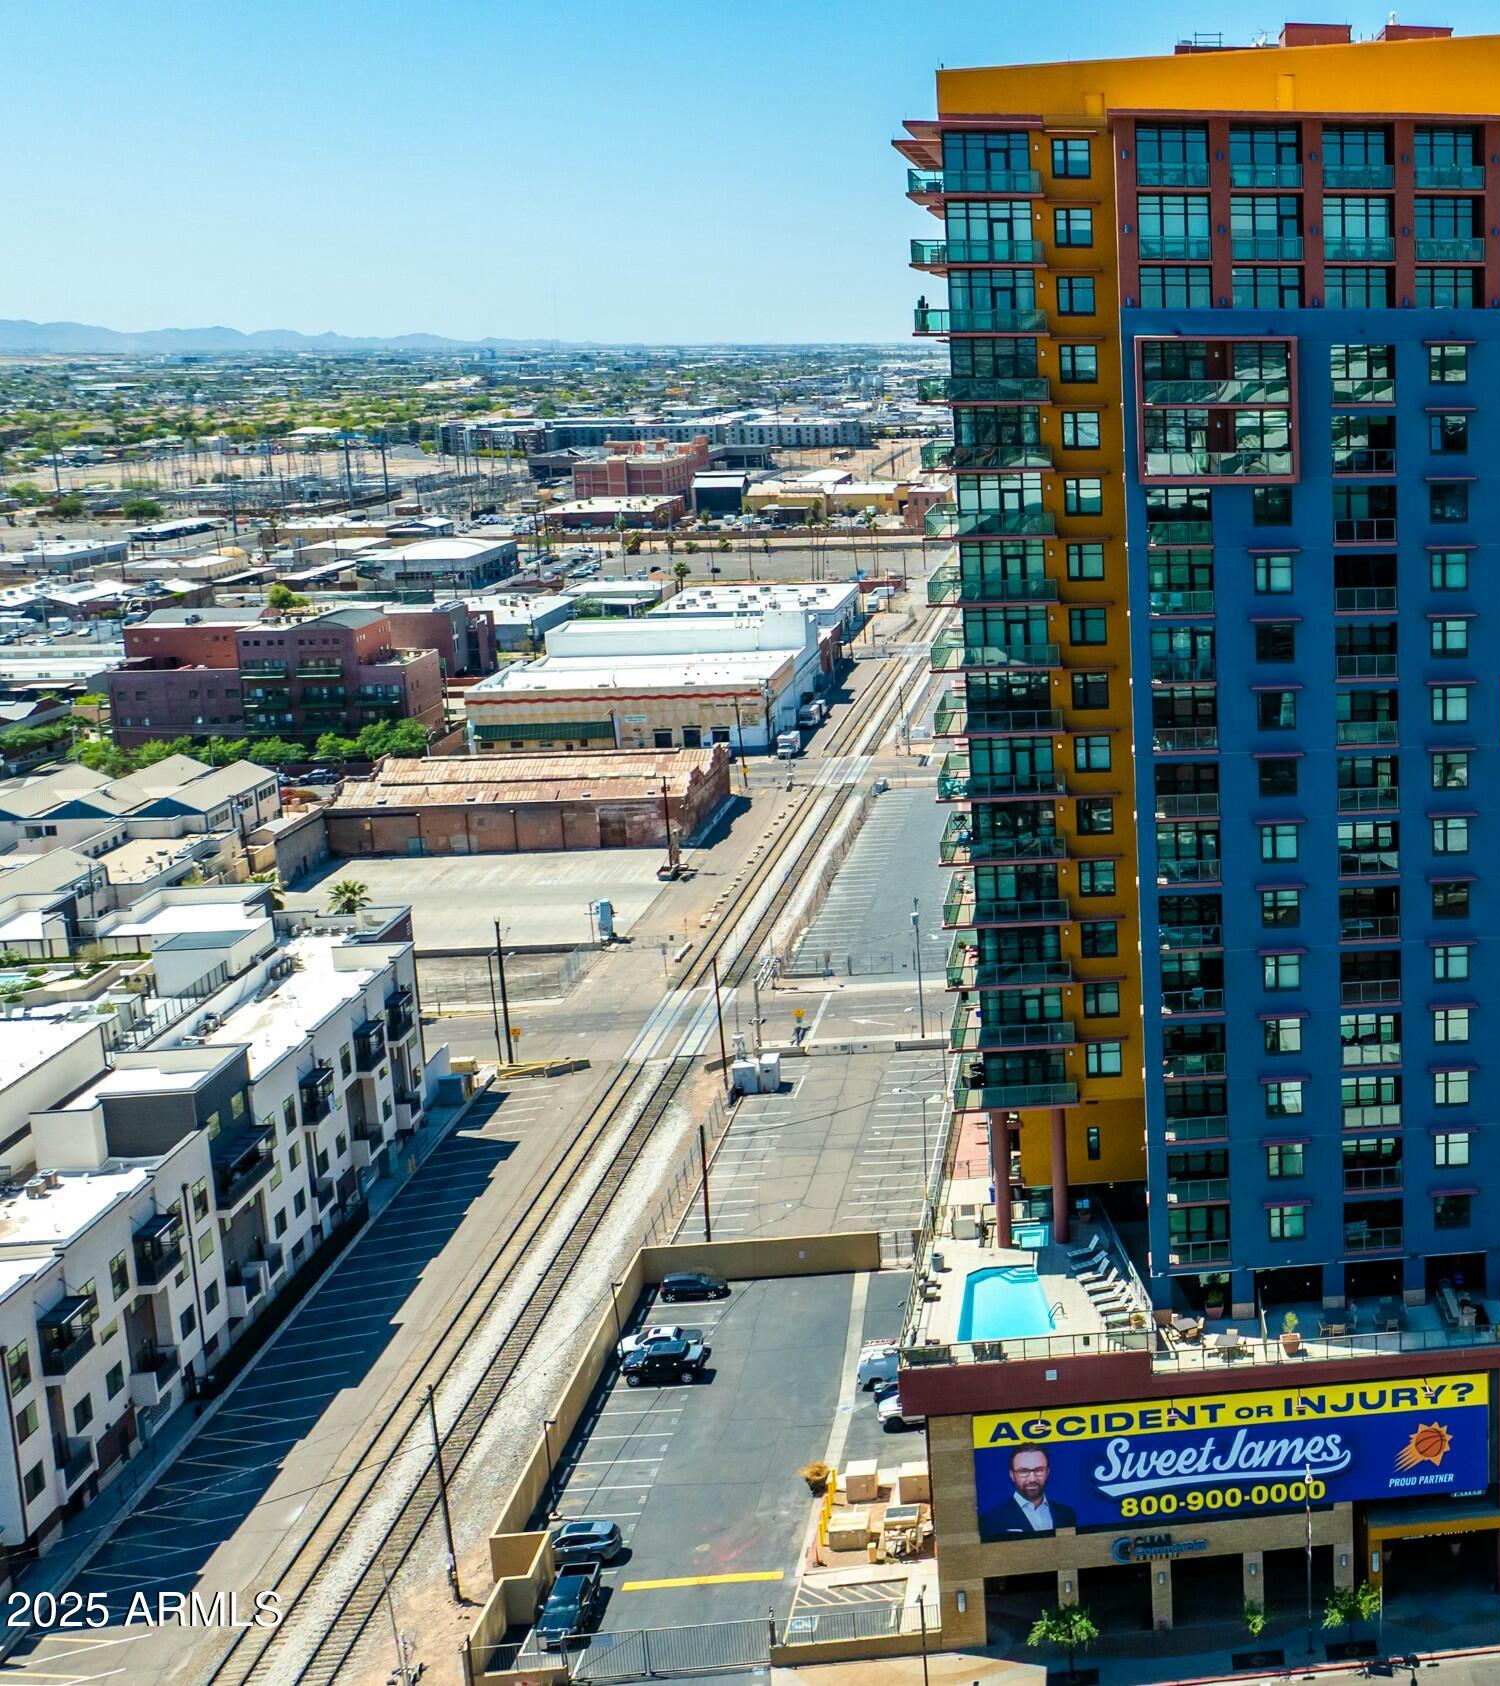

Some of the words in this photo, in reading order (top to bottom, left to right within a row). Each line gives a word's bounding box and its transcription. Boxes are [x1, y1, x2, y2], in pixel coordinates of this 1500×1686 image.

[989, 1403, 1226, 1443] ACCIDENT
[1234, 1404, 1273, 1419] OR
[1284, 1382, 1475, 1418] INJURY?
[1121, 1480, 1326, 1518] 800-900-0000
[1388, 1475, 1417, 1488] PROUD
[1418, 1473, 1454, 1486] PARTNER
